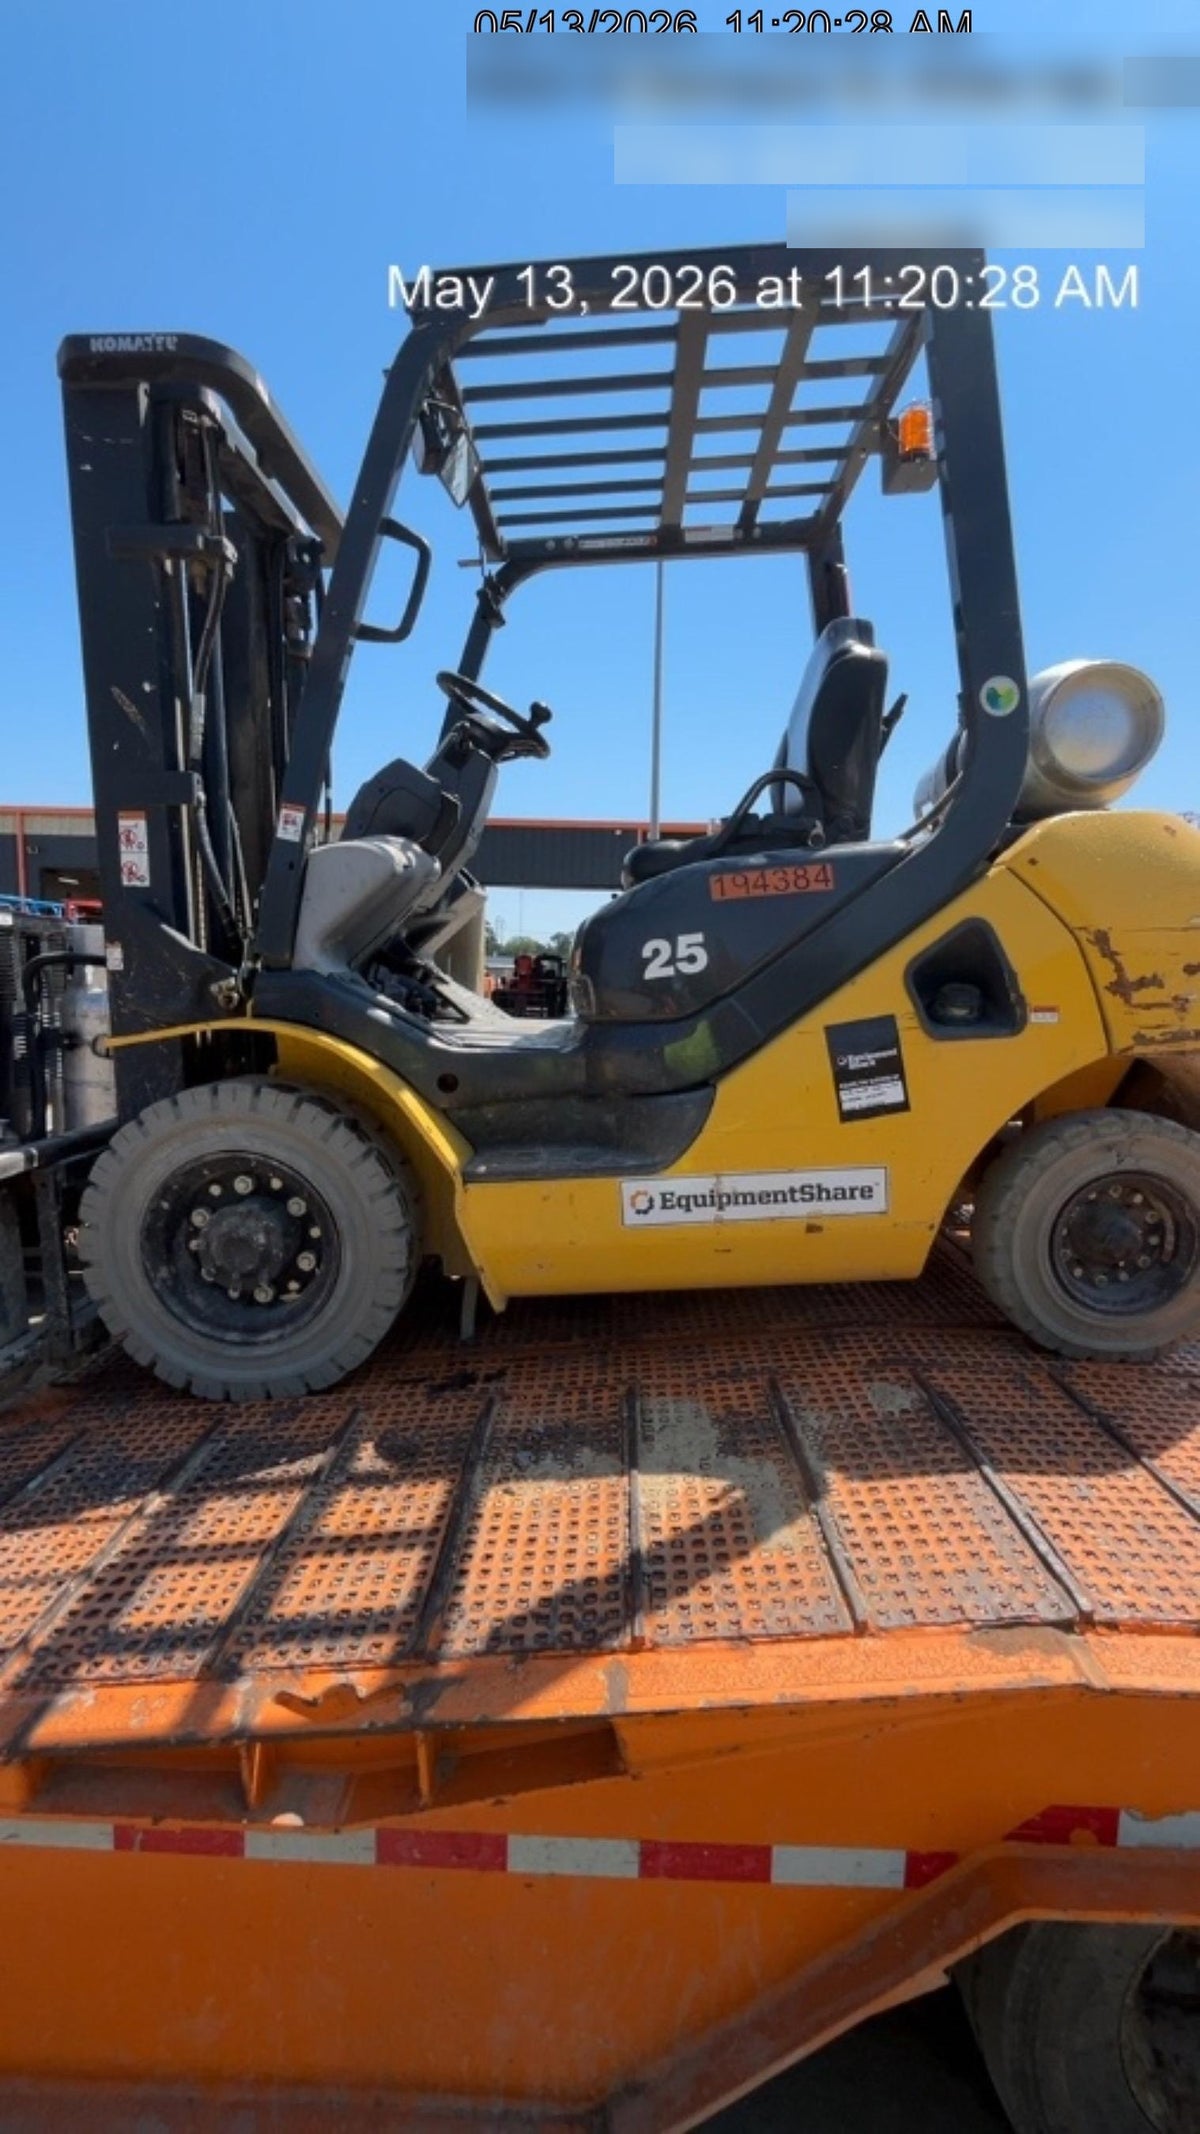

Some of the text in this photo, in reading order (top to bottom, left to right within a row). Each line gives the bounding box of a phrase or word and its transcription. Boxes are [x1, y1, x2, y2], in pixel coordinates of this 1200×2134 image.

[714, 865, 831, 897] 194384
[642, 932, 708, 980] 25
[659, 1183, 874, 1212] EquipmentShare
